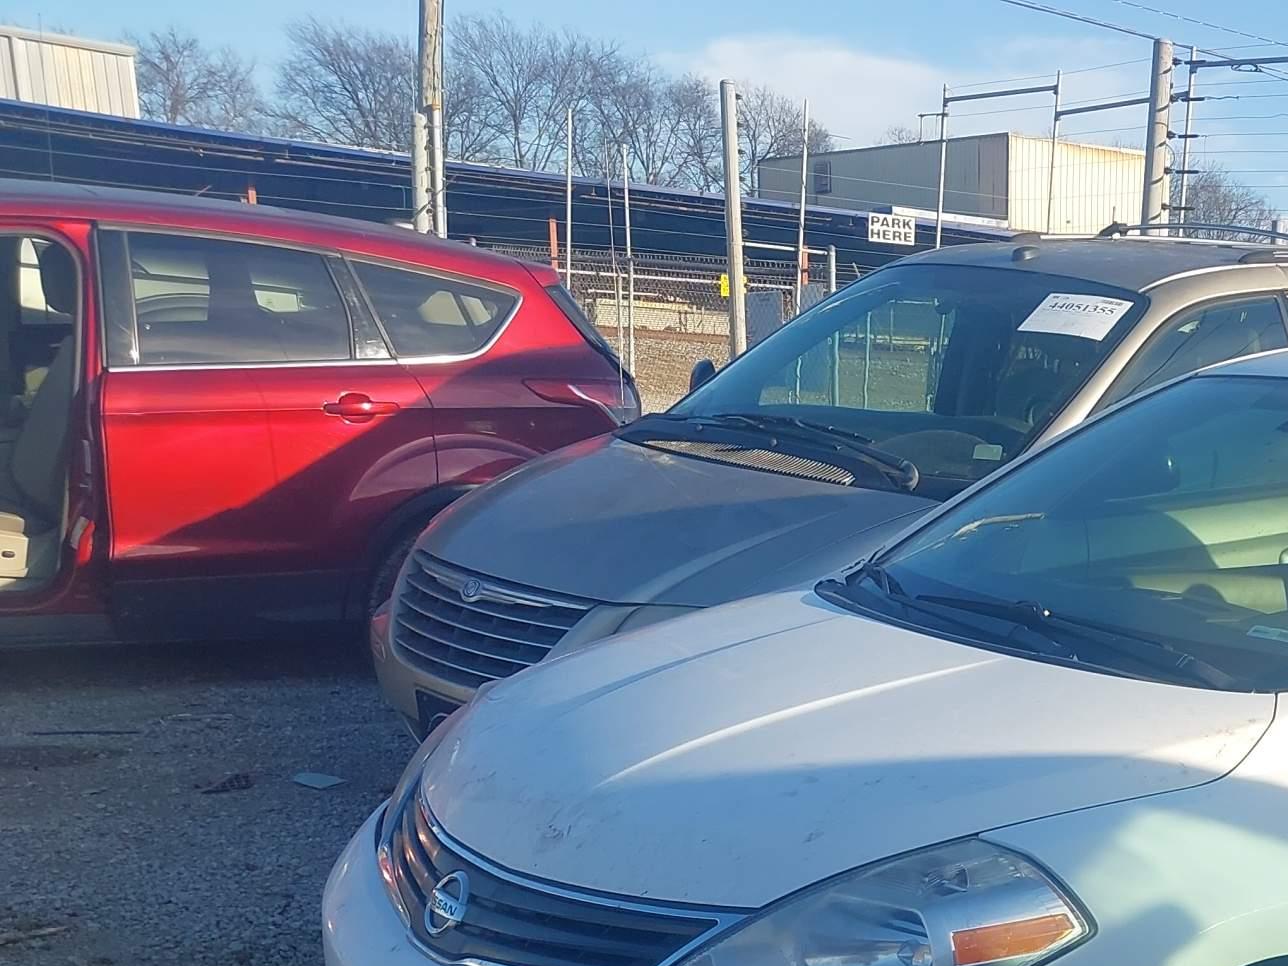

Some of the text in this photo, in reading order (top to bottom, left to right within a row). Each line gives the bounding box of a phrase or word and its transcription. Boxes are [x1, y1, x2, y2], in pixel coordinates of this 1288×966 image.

[870, 215, 913, 230] PARK
[870, 228, 913, 243] HERE
[1048, 302, 1117, 316] 44051355
[430, 894, 458, 916] ISSAN
